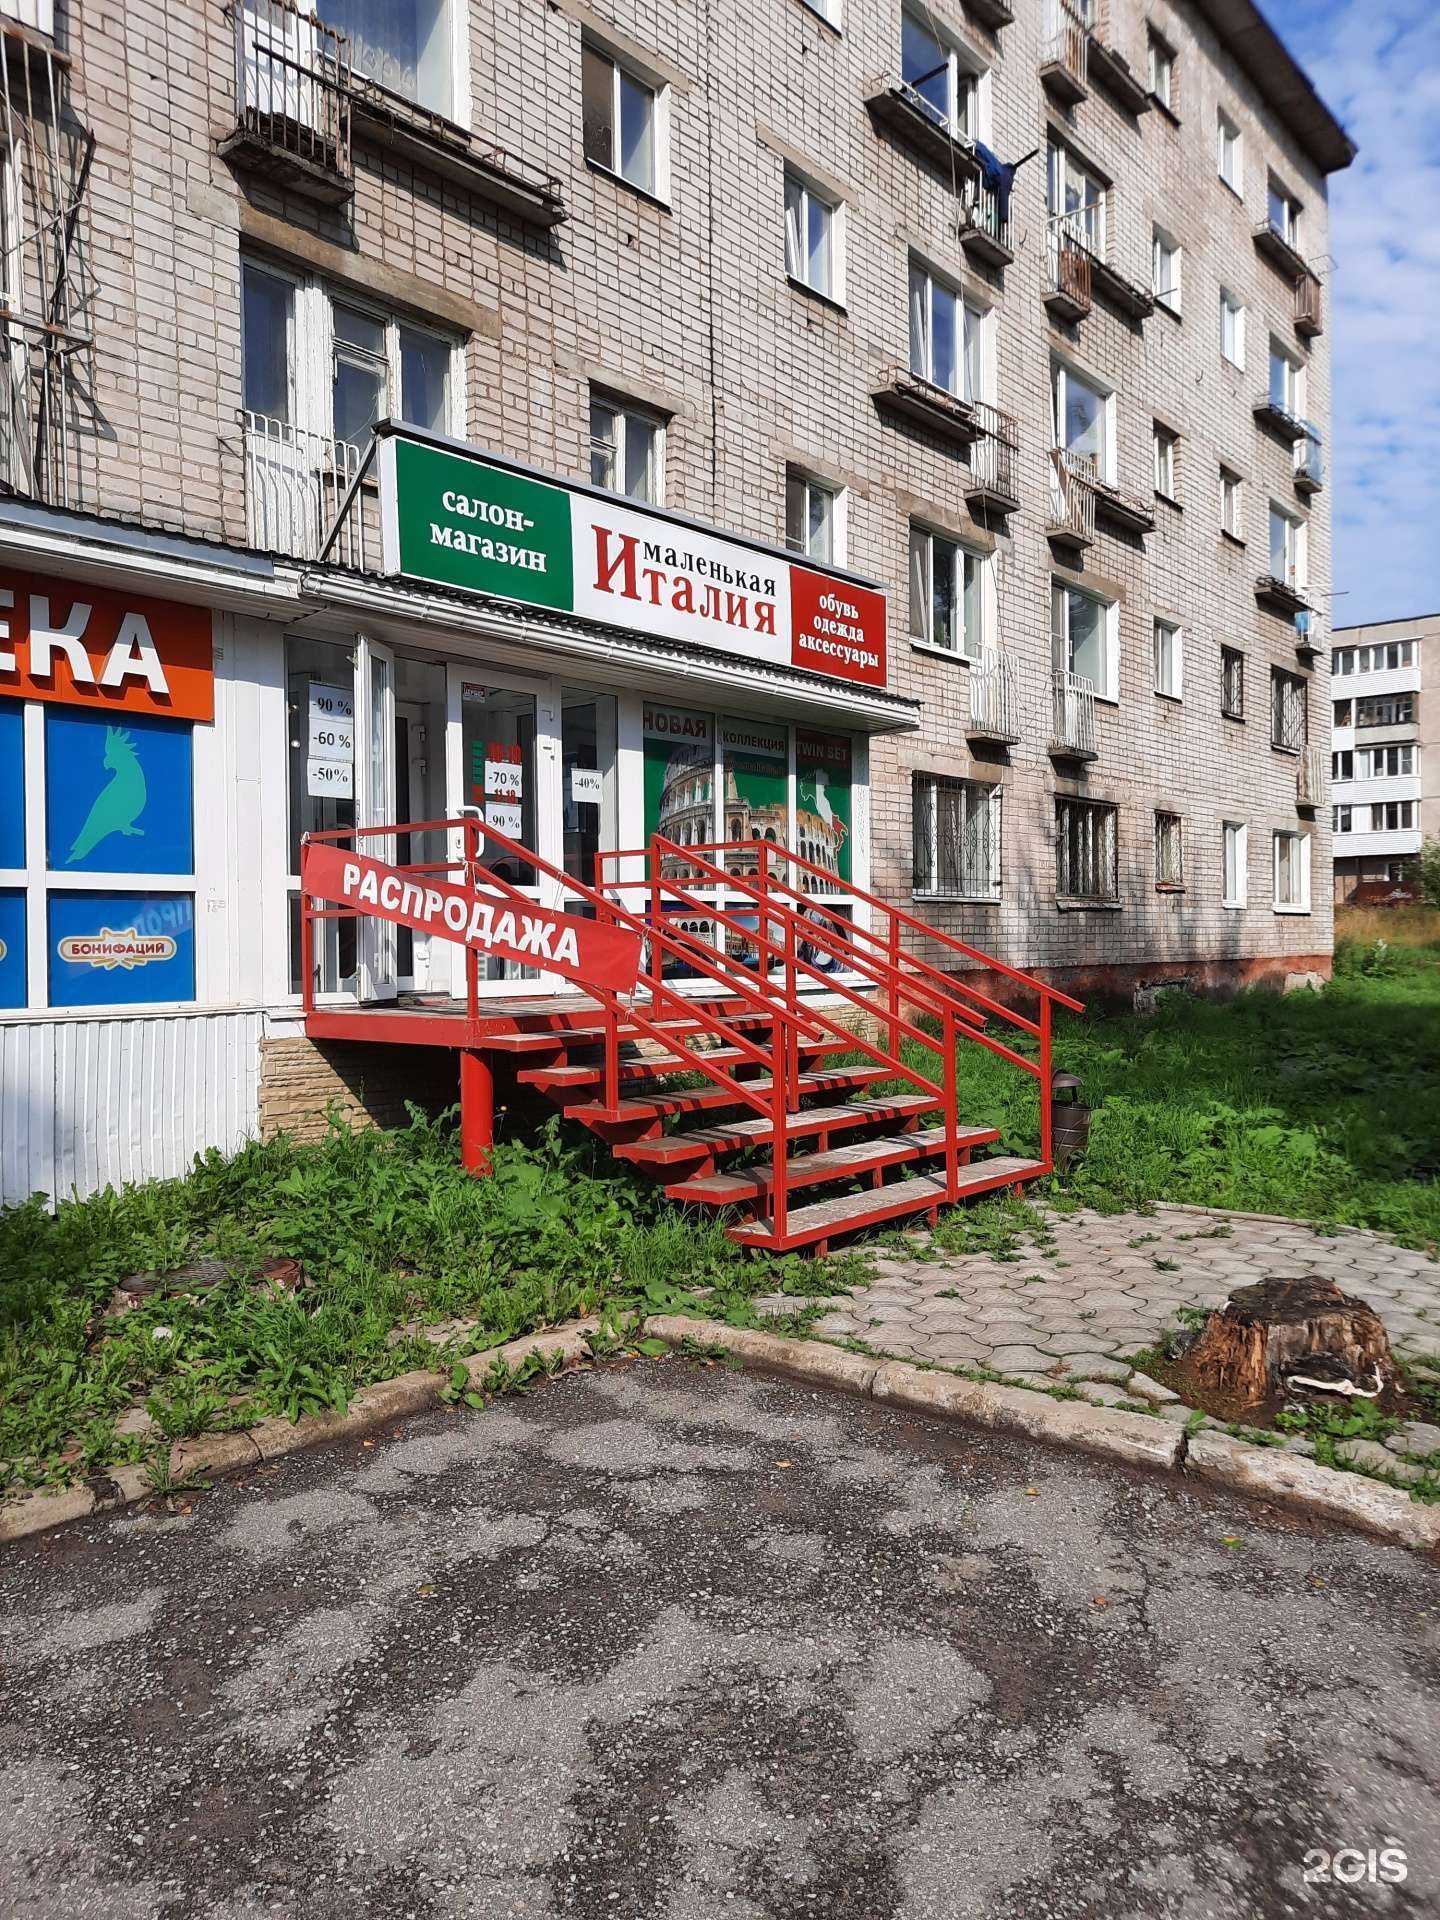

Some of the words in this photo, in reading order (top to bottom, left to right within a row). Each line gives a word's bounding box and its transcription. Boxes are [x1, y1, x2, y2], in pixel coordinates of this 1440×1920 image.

[442, 490, 535, 532] салон-
[430, 522, 547, 573] магазин
[590, 524, 777, 637] Италия
[643, 542, 776, 597] маленькая
[819, 593, 859, 620] обувь
[813, 615, 865, 644] одежда
[798, 633, 880, 669] аксессуары
[313, 731, 335, 746] -60
[643, 711, 707, 738] НОВАЯ
[722, 731, 785, 752] КОЛЛЕКЦИЯ
[312, 767, 348, 783] -50%
[574, 776, 601, 790] -40%
[343, 864, 580, 968] РАСПРОДАЖА
[71, 942, 165, 957] БОНИФАЦИЙ
